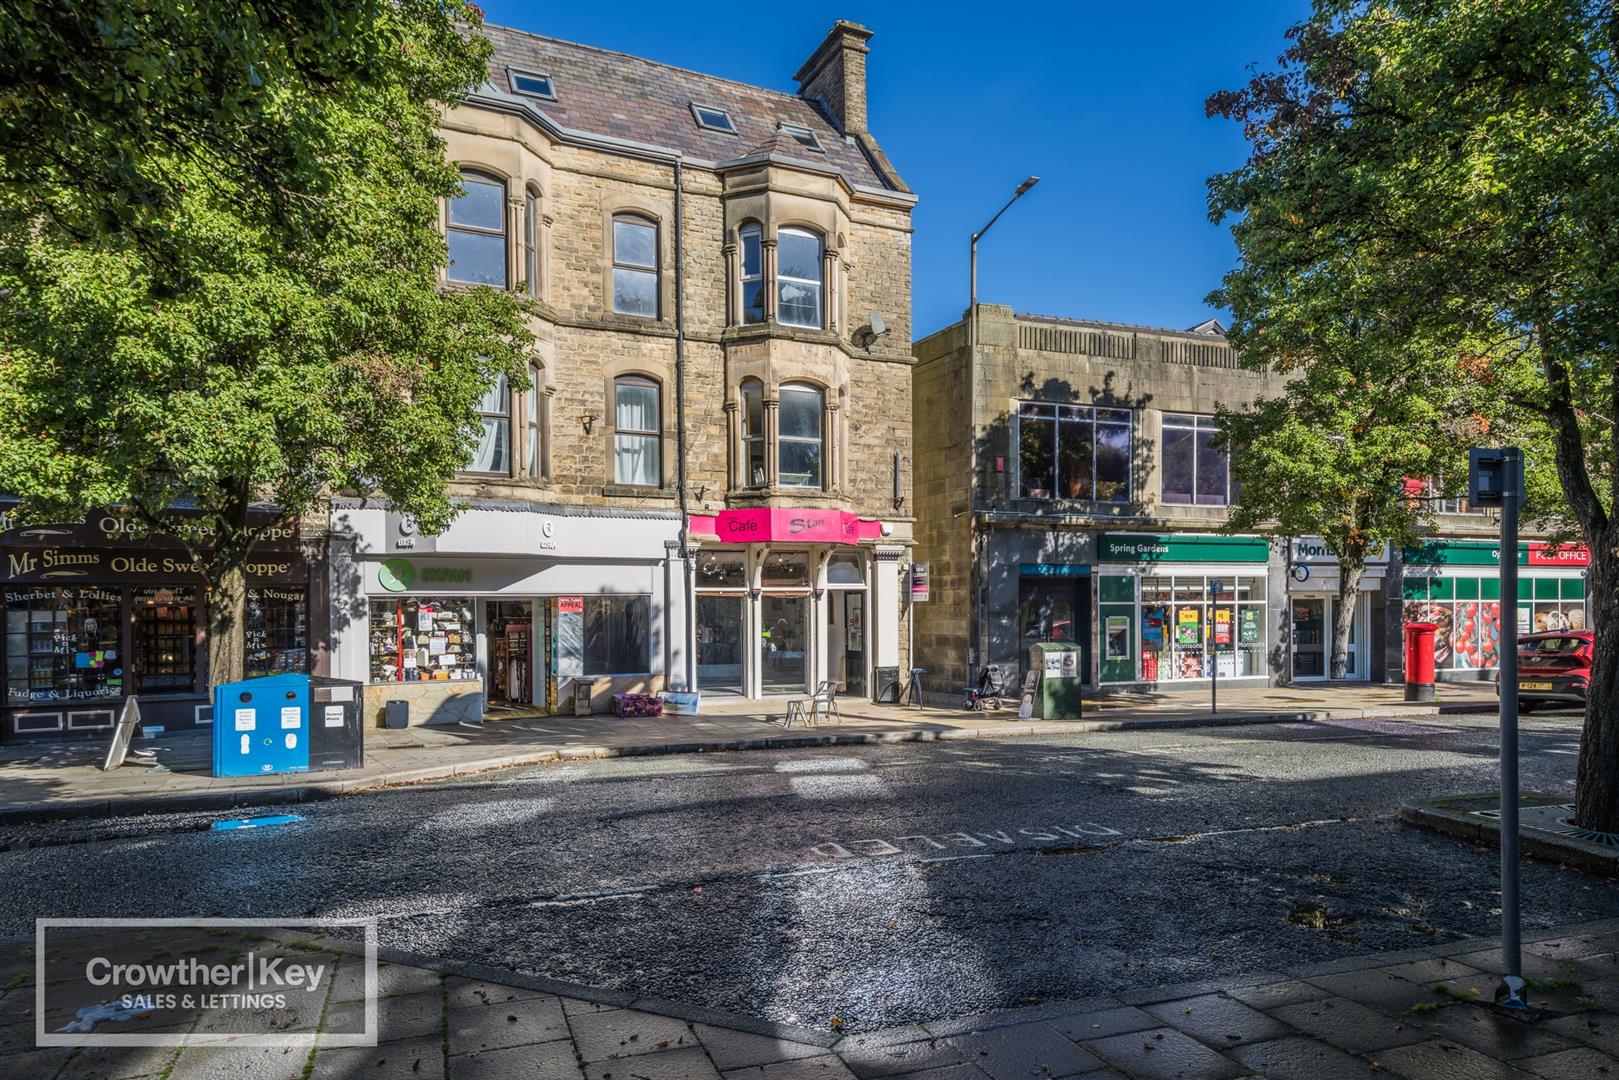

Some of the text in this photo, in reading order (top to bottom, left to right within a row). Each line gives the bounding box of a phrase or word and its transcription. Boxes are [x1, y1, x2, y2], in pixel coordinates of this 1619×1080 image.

[1109, 543, 1169, 555] Spring Gardens
[1558, 550, 1587, 561] OFFICE
[8, 551, 38, 579] Mr
[42, 549, 101, 568] Simms
[111, 556, 158, 573] Olde
[5, 589, 122, 603] Sherbet & Lollies
[247, 589, 259, 598] &
[245, 630, 268, 639] Pick
[7, 686, 121, 699] Fudge & Liquorice
